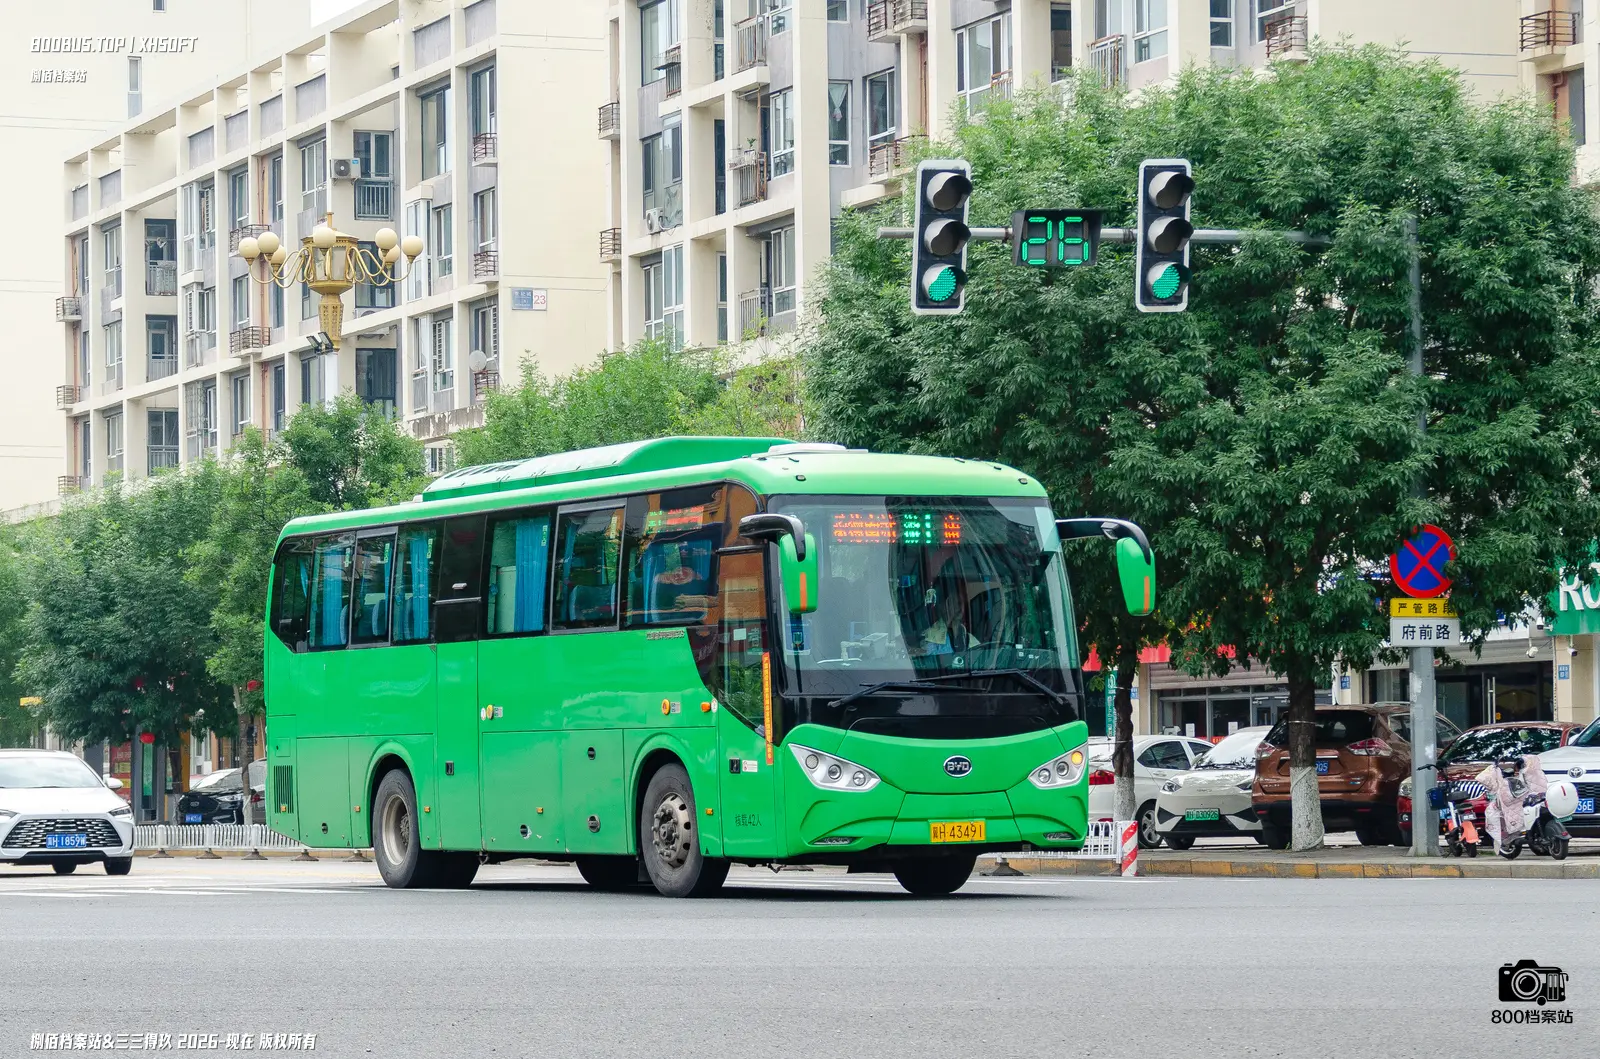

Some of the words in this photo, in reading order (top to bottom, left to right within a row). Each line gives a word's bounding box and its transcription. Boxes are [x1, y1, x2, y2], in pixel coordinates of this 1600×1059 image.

[1022, 216, 1089, 265] 26
[533, 295, 546, 305] 23
[1401, 624, 1450, 640] 府前路
[947, 761, 970, 771] BYD
